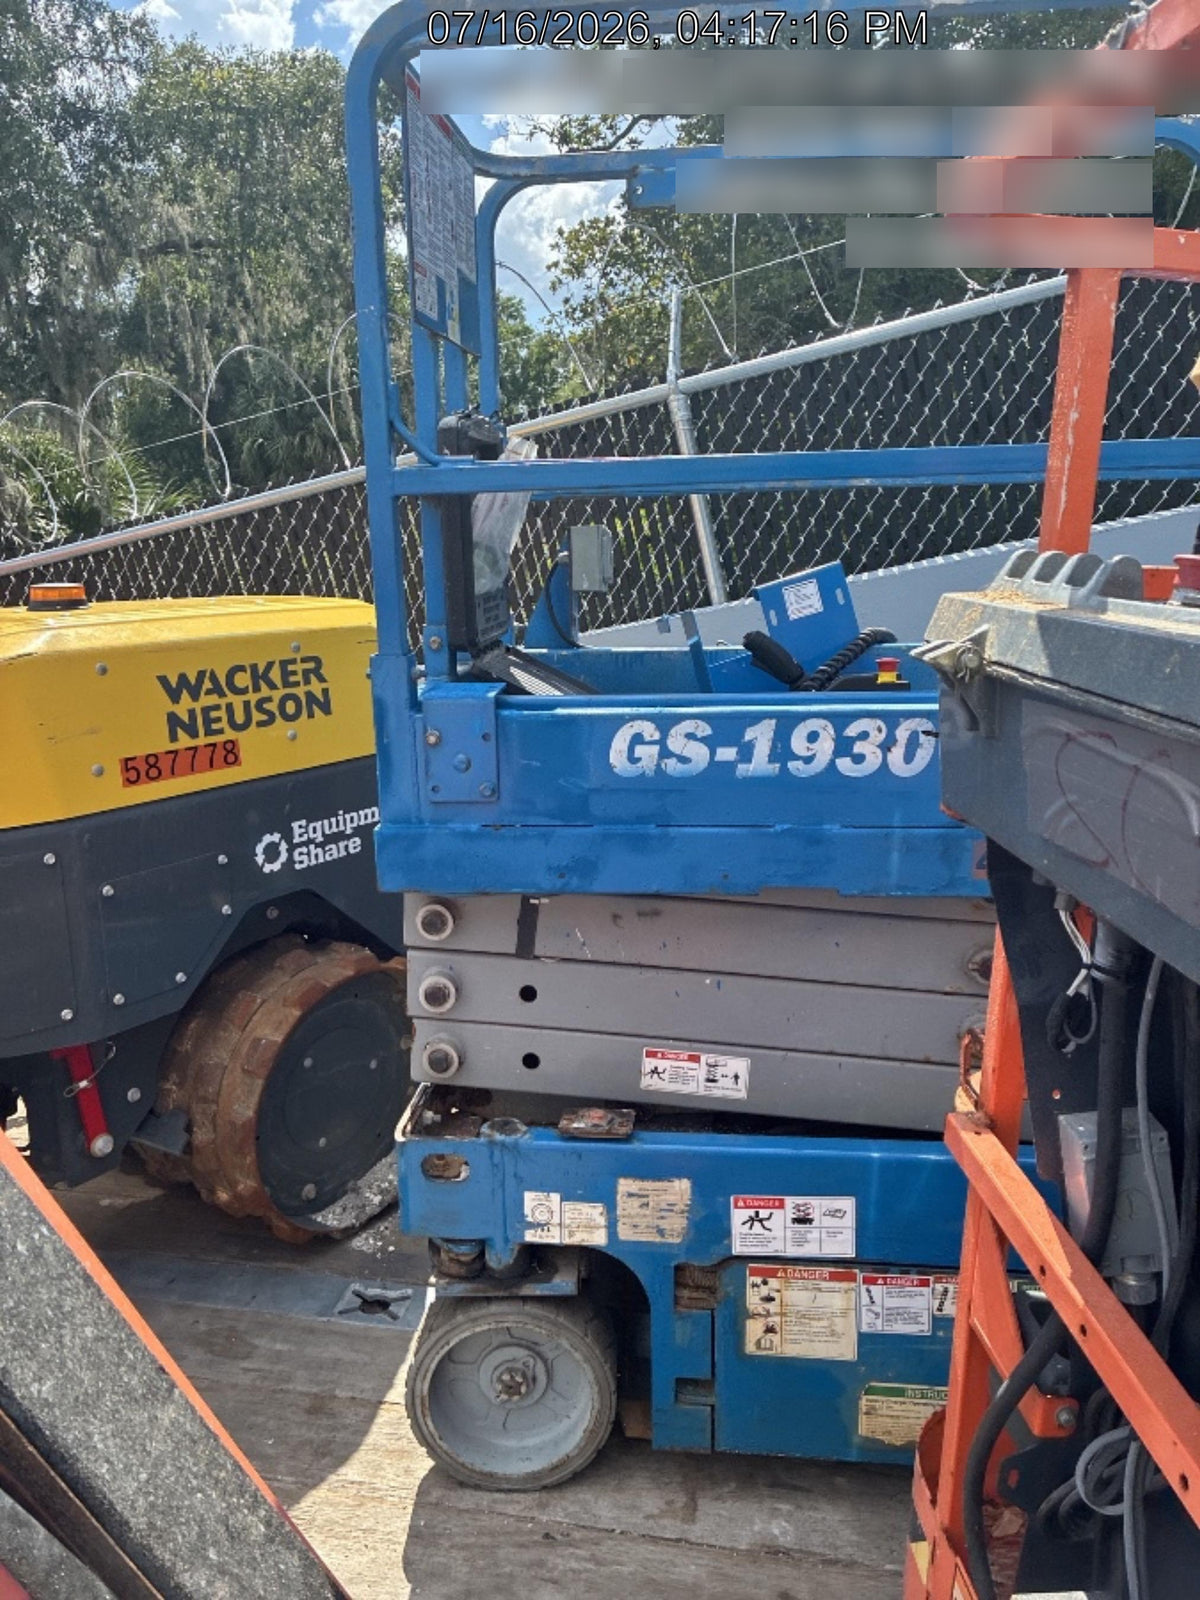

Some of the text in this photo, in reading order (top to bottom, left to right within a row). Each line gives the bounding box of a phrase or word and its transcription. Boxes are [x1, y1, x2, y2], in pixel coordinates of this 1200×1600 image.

[156, 655, 328, 705] WACKER
[166, 687, 333, 743] NEUSON
[124, 739, 240, 785] 587778
[609, 717, 937, 778] GS-1930
[293, 836, 362, 870] Share
[746, 1198, 779, 1207] DANGER
[787, 1269, 830, 1280] DANGER
